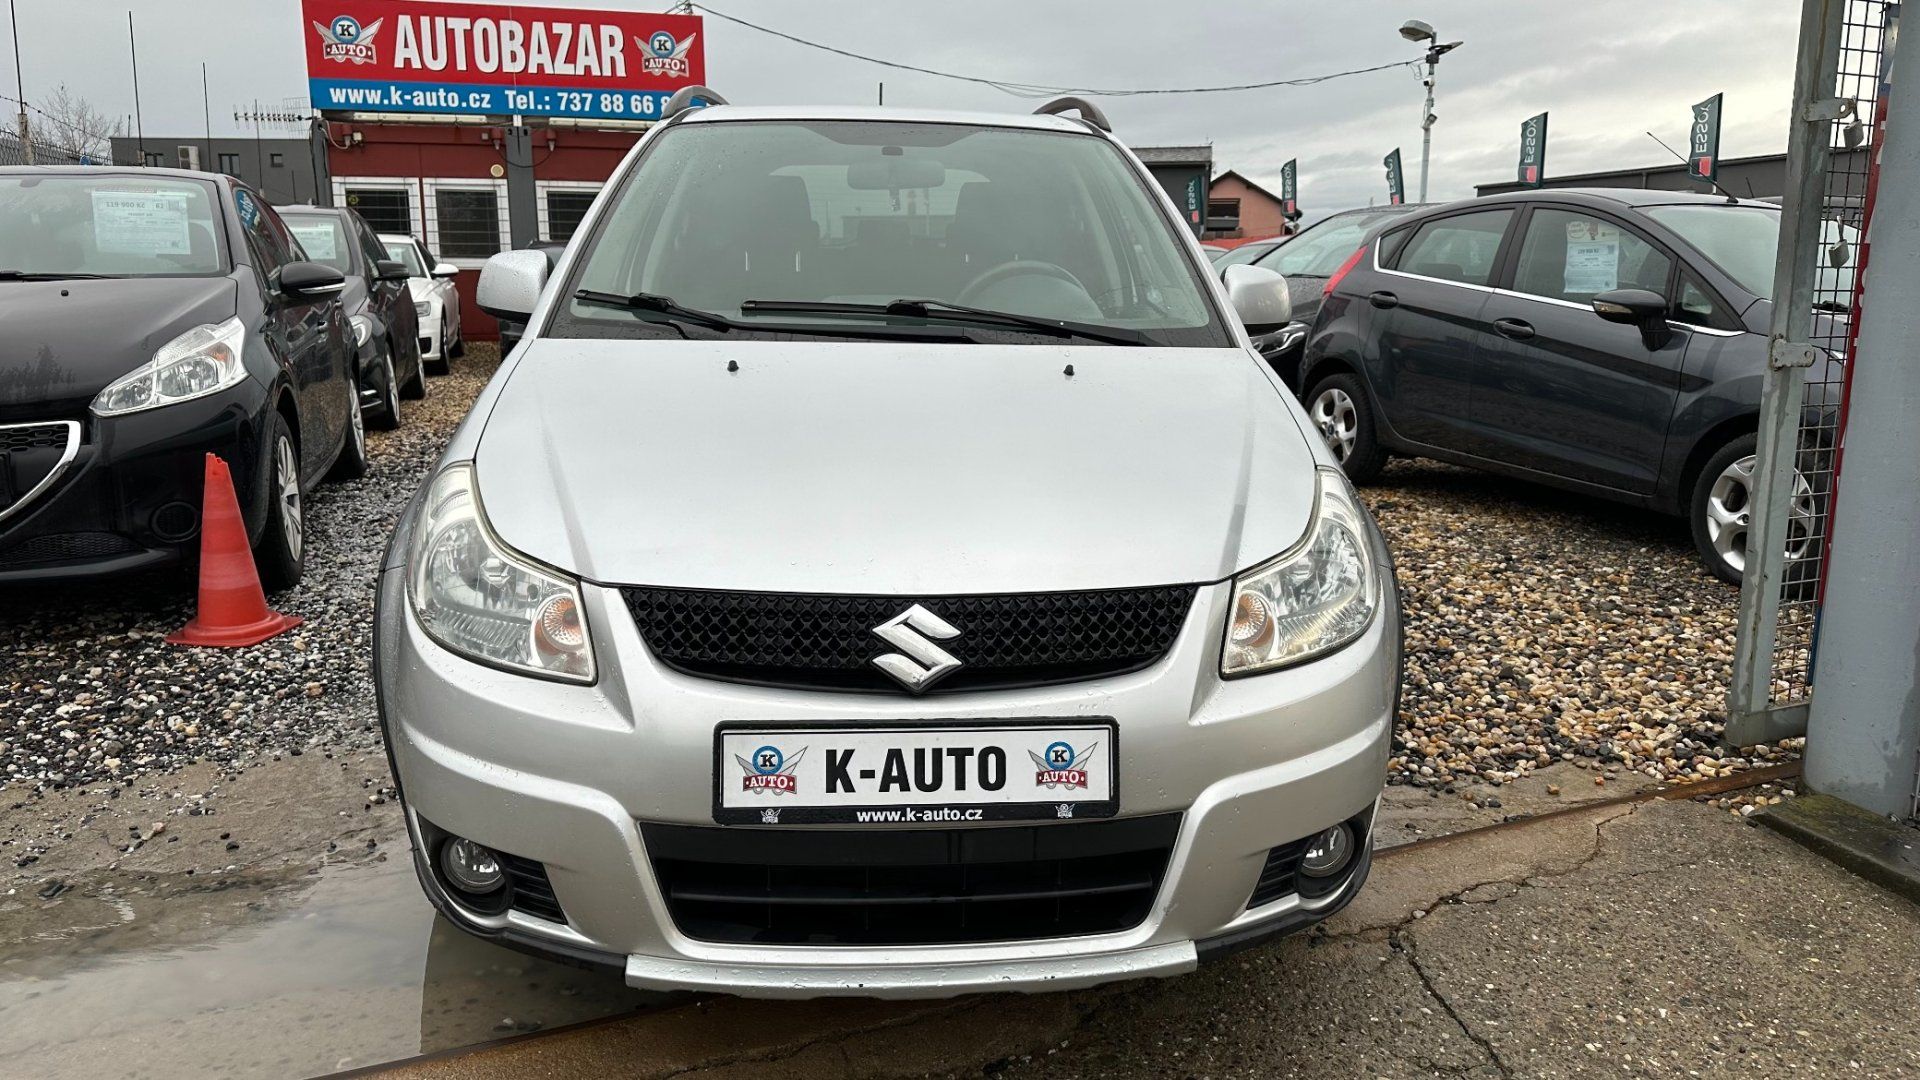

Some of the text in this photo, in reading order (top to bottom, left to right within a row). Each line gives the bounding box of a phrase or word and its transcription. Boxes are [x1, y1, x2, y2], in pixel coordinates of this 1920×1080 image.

[338, 24, 354, 37] K
[330, 44, 367, 57] AUTO
[394, 15, 627, 77] AUTOBAZAR
[656, 39, 669, 51] K
[648, 58, 681, 71] AUTO
[330, 85, 492, 109] www.k-auto.cz
[505, 89, 551, 111] Tel.:
[557, 91, 592, 112] 737
[600, 92, 624, 113] 88
[630, 93, 654, 115] 66
[760, 753, 776, 767] K
[1052, 749, 1068, 763] K
[825, 746, 1007, 793] K-AUTO
[749, 774, 788, 789] AUTO
[1042, 771, 1079, 785] AUTO
[856, 807, 983, 823] www.k-auto.cz
